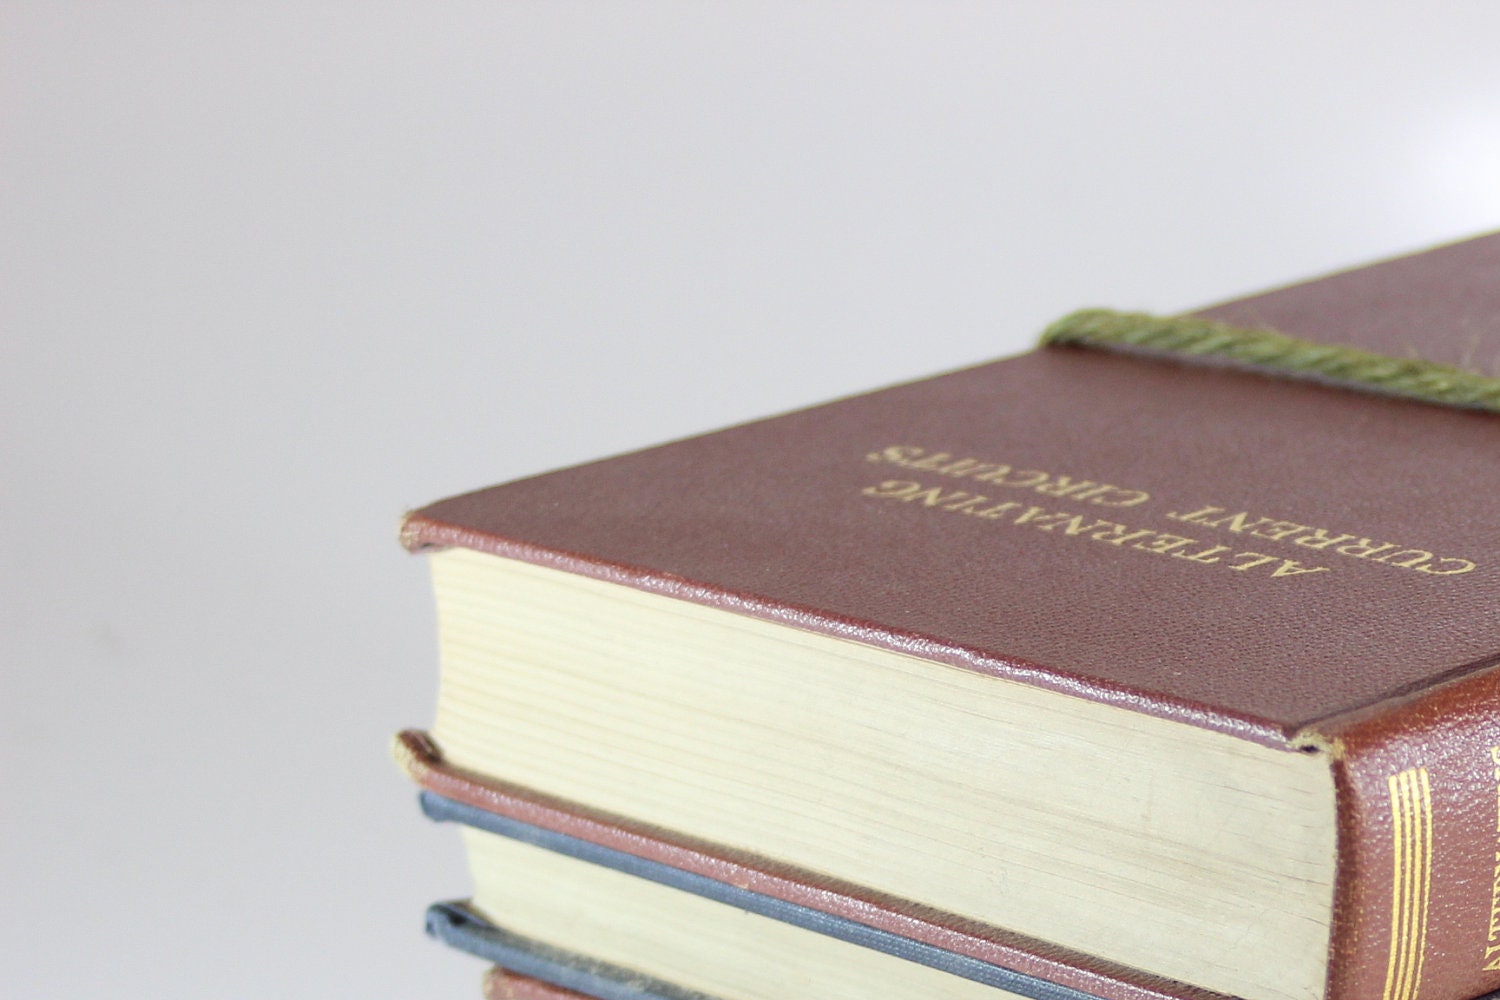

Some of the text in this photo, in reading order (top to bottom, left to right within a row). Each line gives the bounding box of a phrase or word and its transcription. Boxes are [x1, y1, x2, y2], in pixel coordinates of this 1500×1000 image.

[861, 480, 1330, 577] ALTERNATING
[866, 446, 1477, 575] CURRENT CIRCUITS
